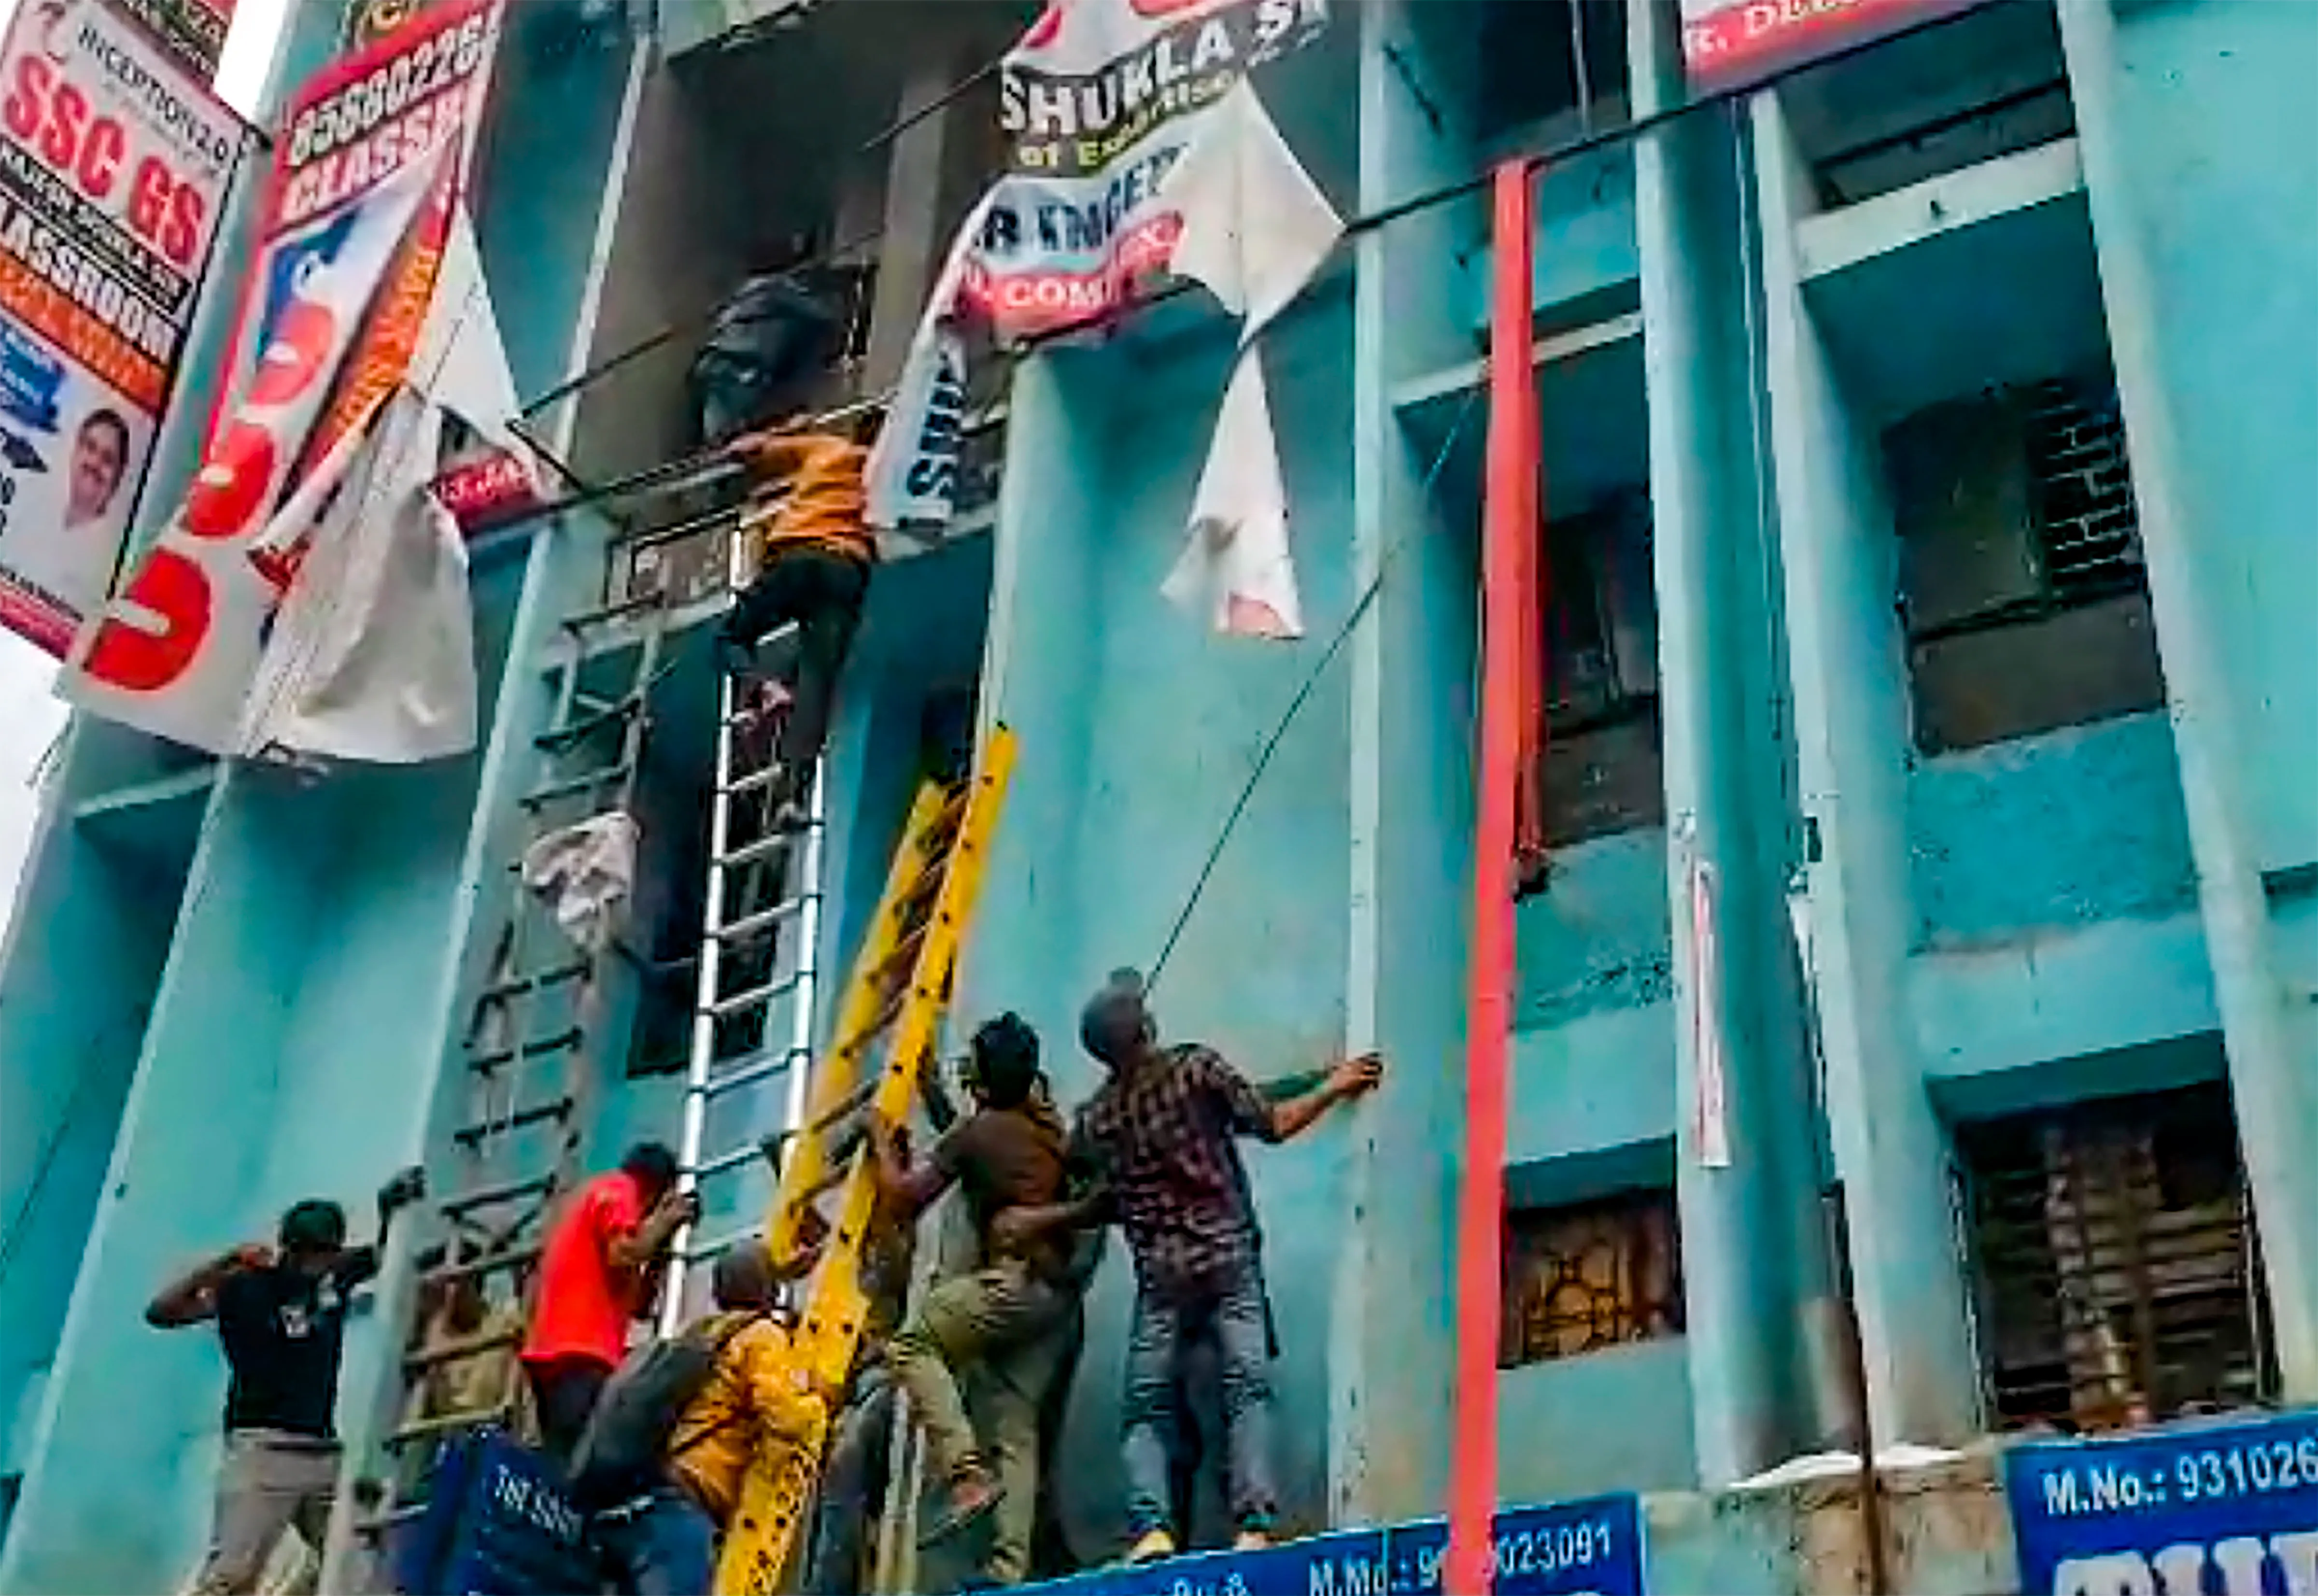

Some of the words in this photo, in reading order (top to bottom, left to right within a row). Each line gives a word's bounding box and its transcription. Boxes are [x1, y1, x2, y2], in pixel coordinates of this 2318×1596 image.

[1000, 20, 1235, 134] SHUKLA
[5, 55, 124, 197] SSC
[131, 156, 203, 265] GS
